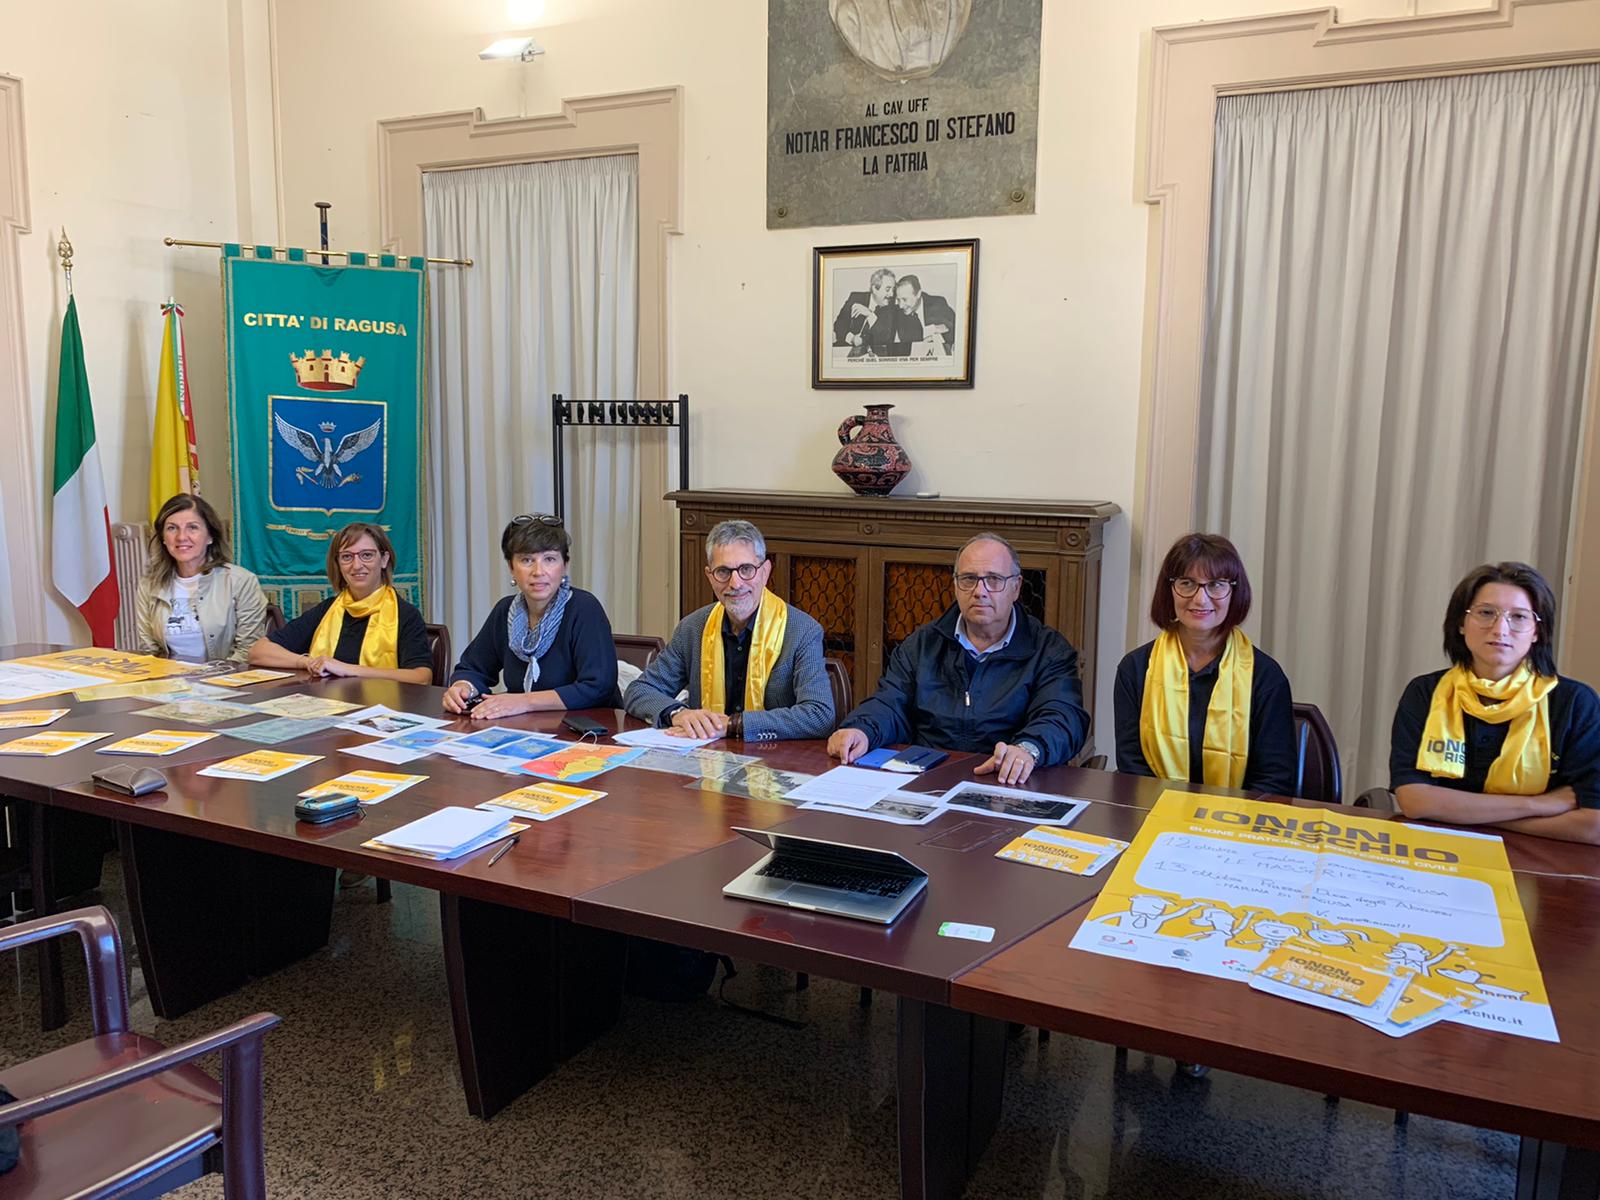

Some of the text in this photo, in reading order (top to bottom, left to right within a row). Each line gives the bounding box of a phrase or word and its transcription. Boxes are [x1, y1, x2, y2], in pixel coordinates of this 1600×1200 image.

[865, 103, 879, 118] AL
[883, 101, 904, 116] CAV.
[786, 111, 1015, 155] NOTAR FRANCESCO DI STEFANO
[863, 151, 928, 176] LA PATRIA
[243, 312, 407, 337] CITTA' DI RAGUSA
[1164, 836, 1191, 849] 12
[1188, 825, 1234, 837] BUONE
[1238, 832, 1301, 846] PRATICHE
[1413, 861, 1459, 873] CIVILE
[1251, 825, 1459, 864] RISCHIO
[1154, 860, 1187, 873] 13
[1386, 881, 1449, 897] RAGUSA
[1459, 1007, 1523, 1026] schio.it
